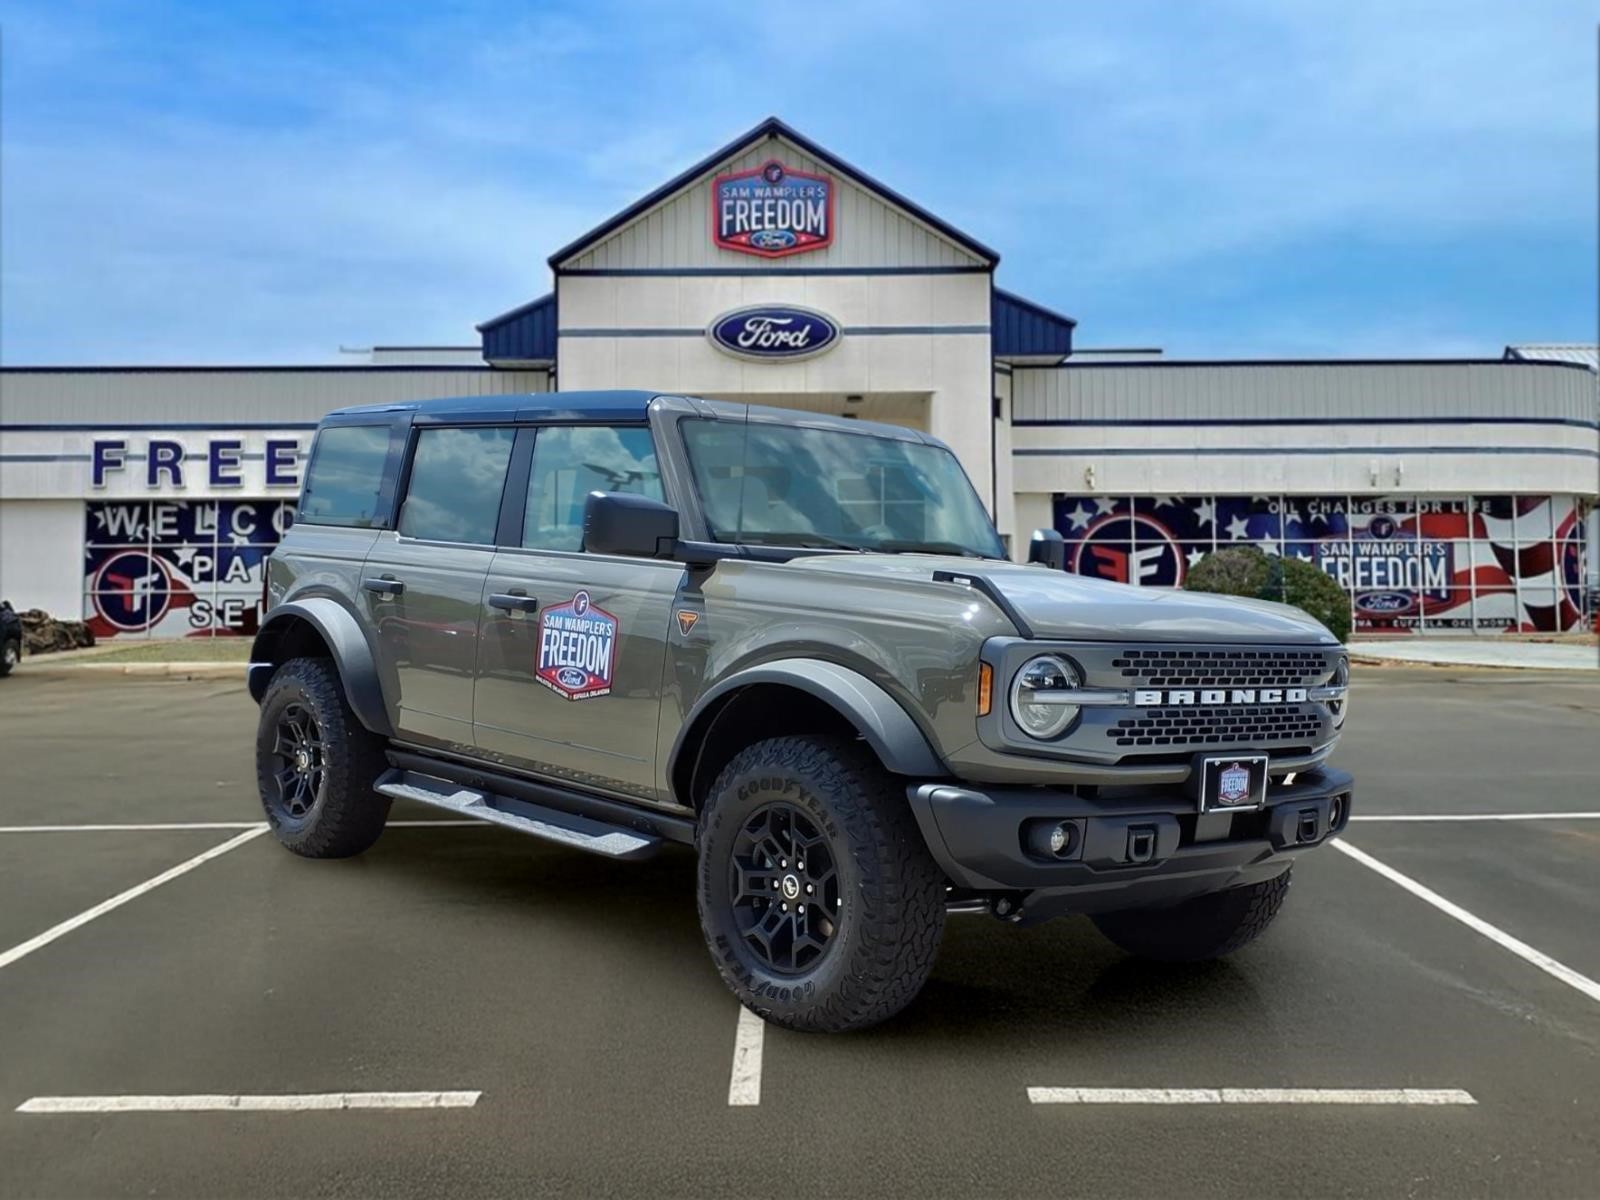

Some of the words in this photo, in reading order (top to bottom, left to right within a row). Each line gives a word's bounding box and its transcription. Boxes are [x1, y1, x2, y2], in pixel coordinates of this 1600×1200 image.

[722, 187, 750, 198] SAM
[754, 187, 826, 198] WAMPLER'S
[721, 199, 825, 236] FREEDOM
[758, 232, 788, 248] Ford
[737, 316, 811, 348] Ford
[1267, 501, 1299, 514] OIL
[1308, 501, 1397, 514] CHANGES
[1405, 501, 1443, 514] FOR
[1451, 500, 1492, 514] LIFE
[1320, 543, 1353, 556] SAM
[192, 555, 268, 582] PA
[1321, 556, 1447, 599] FREEDOM
[1365, 593, 1402, 610] Ford
[190, 601, 264, 627] SE
[543, 614, 563, 628] SAM
[564, 617, 612, 637] WAMPLER'S
[540, 628, 612, 681] FREEDOM
[561, 670, 582, 685] Ford
[1134, 688, 1307, 705] BRONCO
[1220, 777, 1249, 794] FREEDOM
